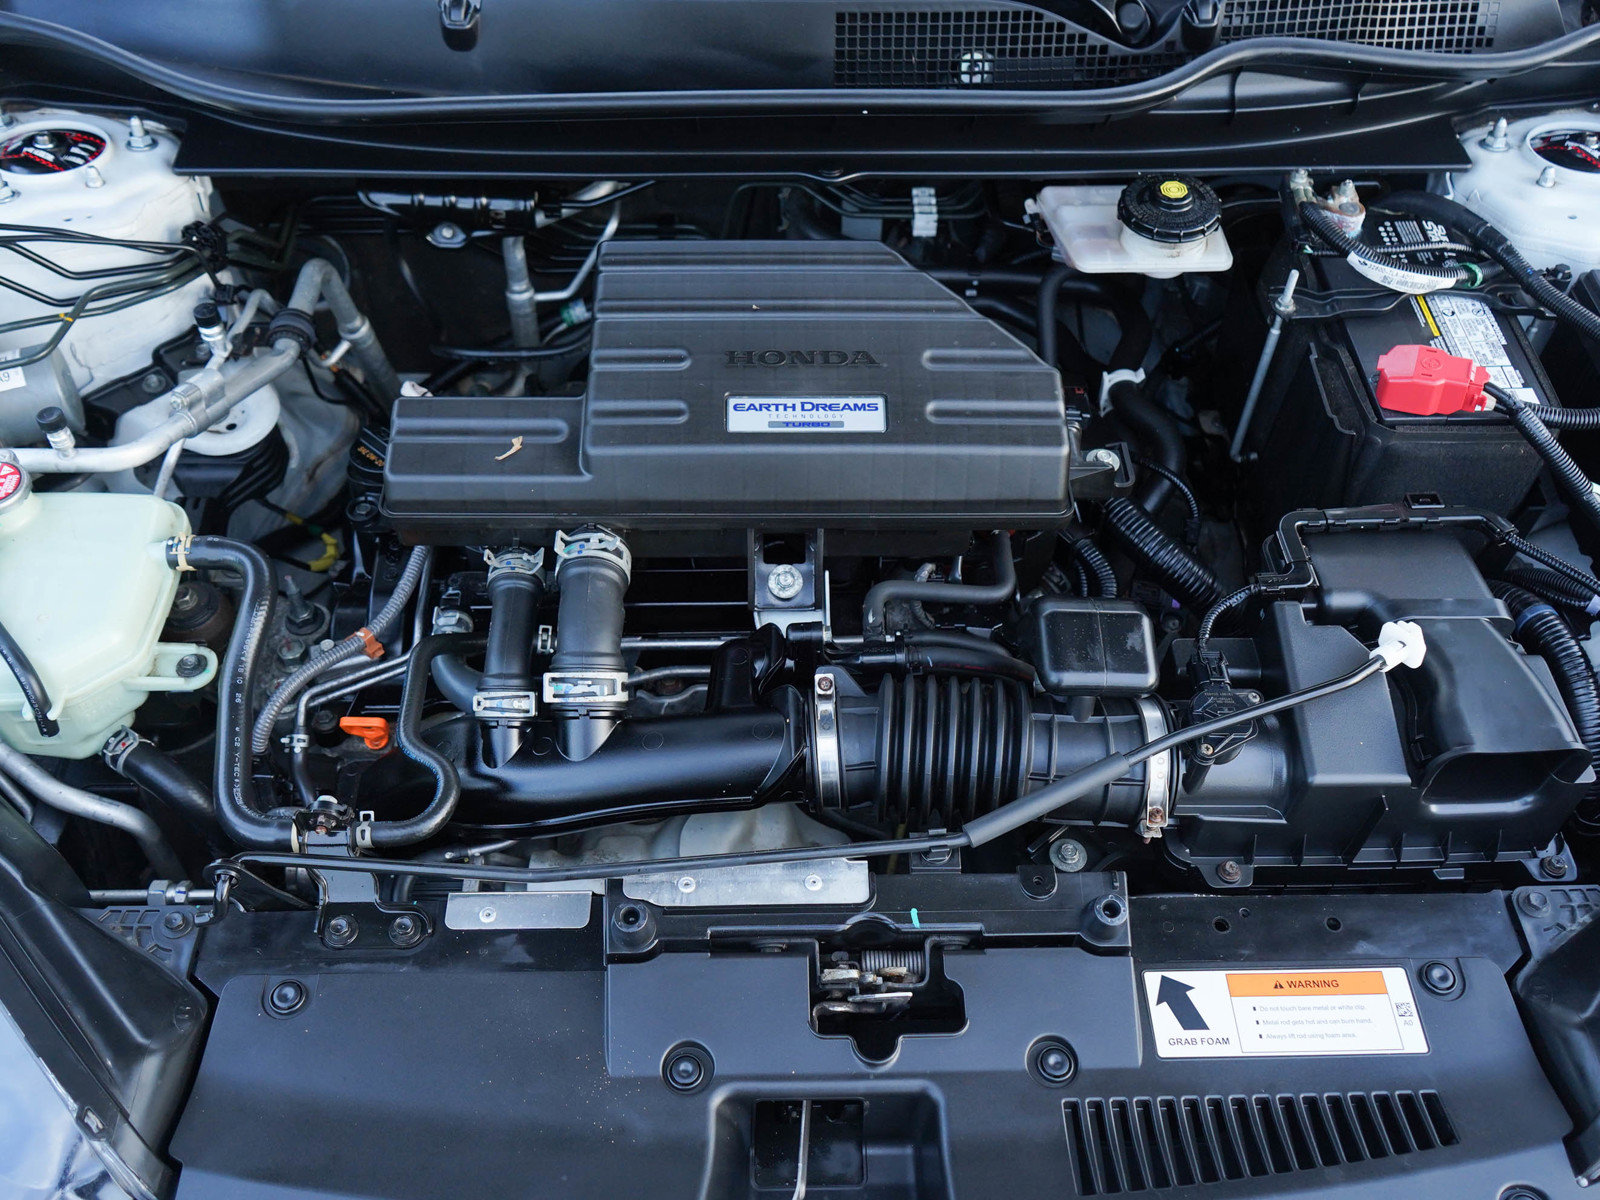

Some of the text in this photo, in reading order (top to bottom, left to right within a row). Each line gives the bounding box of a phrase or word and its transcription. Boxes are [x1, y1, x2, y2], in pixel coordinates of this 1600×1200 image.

[726, 350, 880, 366] HONDA
[733, 401, 879, 412] EARTH DREAMS
[234, 736, 241, 747] C2
[1286, 979, 1339, 989] WARNING
[1168, 1037, 1231, 1046] GRAB FOAM
